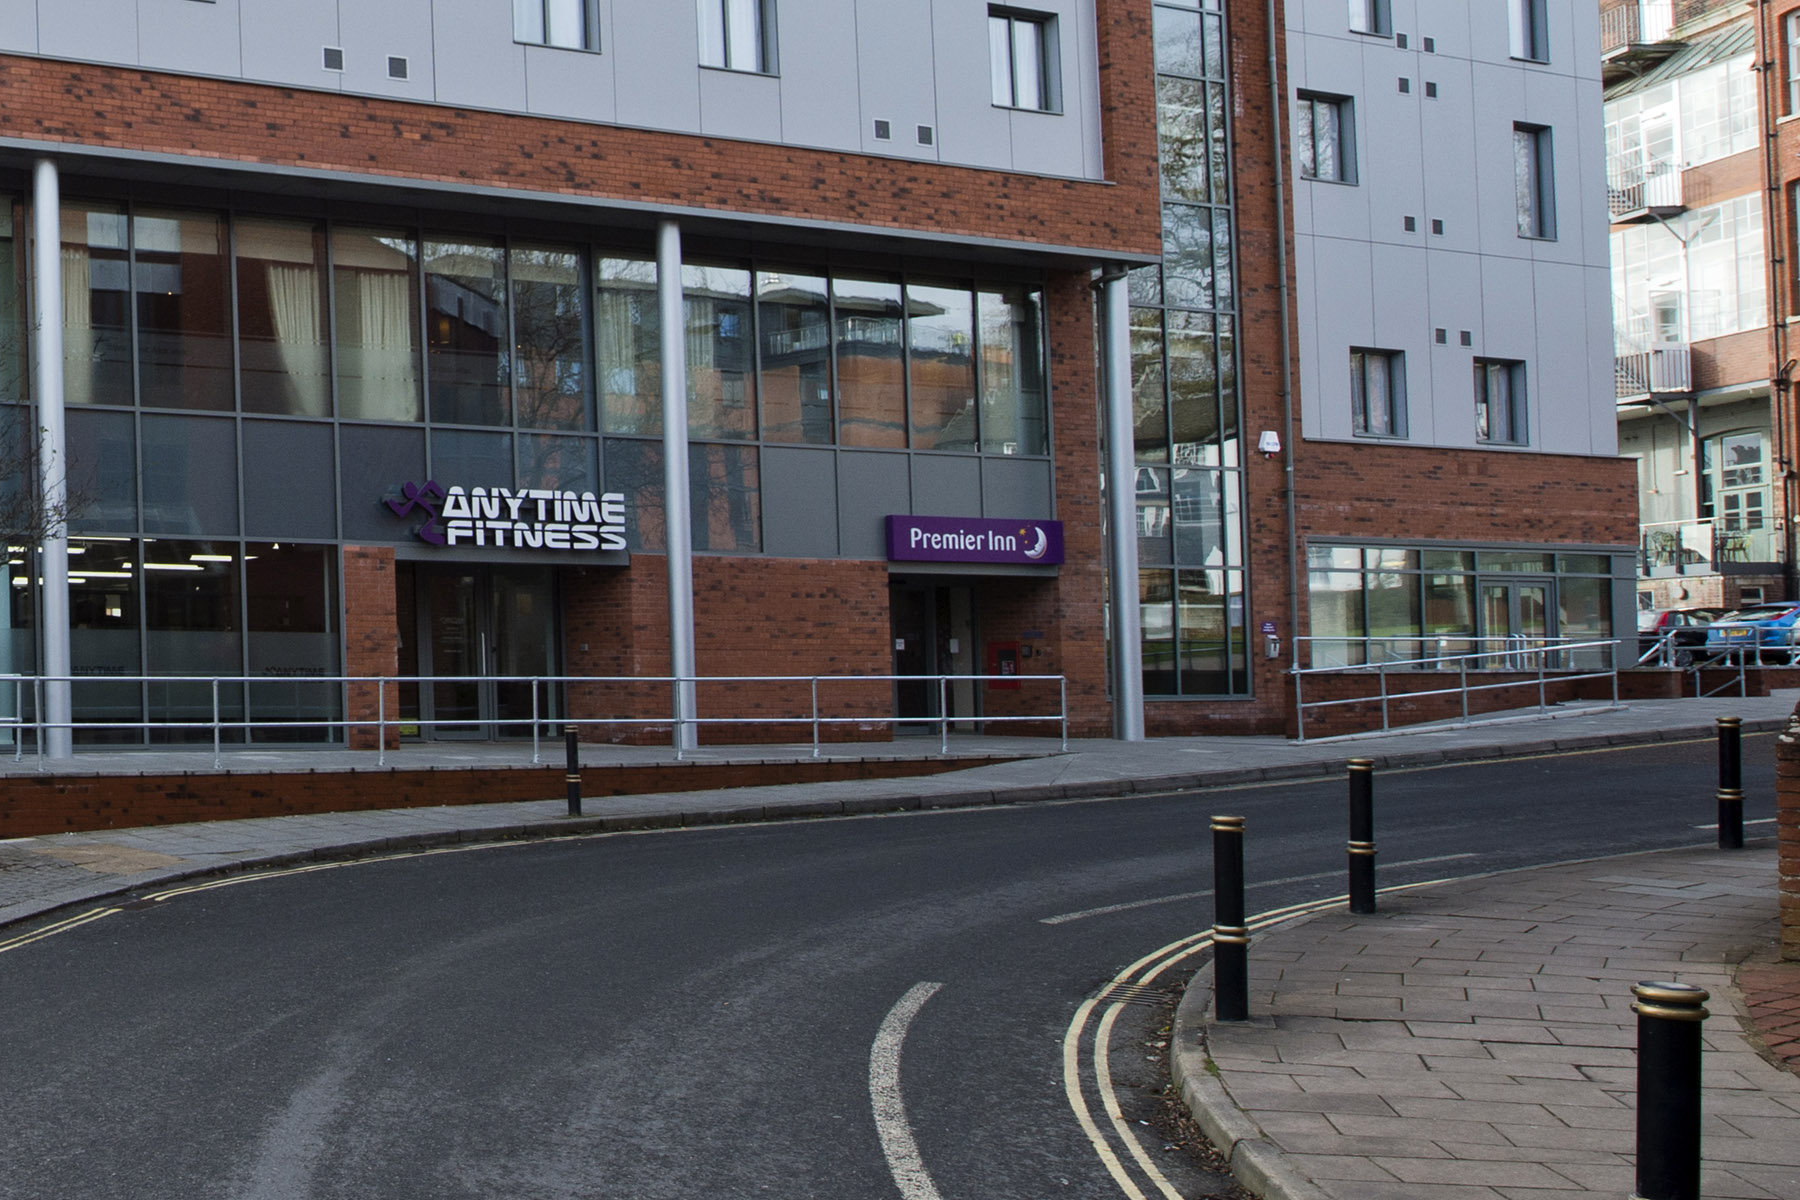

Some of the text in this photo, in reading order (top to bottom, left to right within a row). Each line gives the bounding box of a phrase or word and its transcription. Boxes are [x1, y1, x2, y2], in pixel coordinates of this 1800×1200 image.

[442, 486, 626, 524] ANYTIME
[447, 520, 627, 550] FITNESS
[910, 527, 1016, 551] Premier Inn
